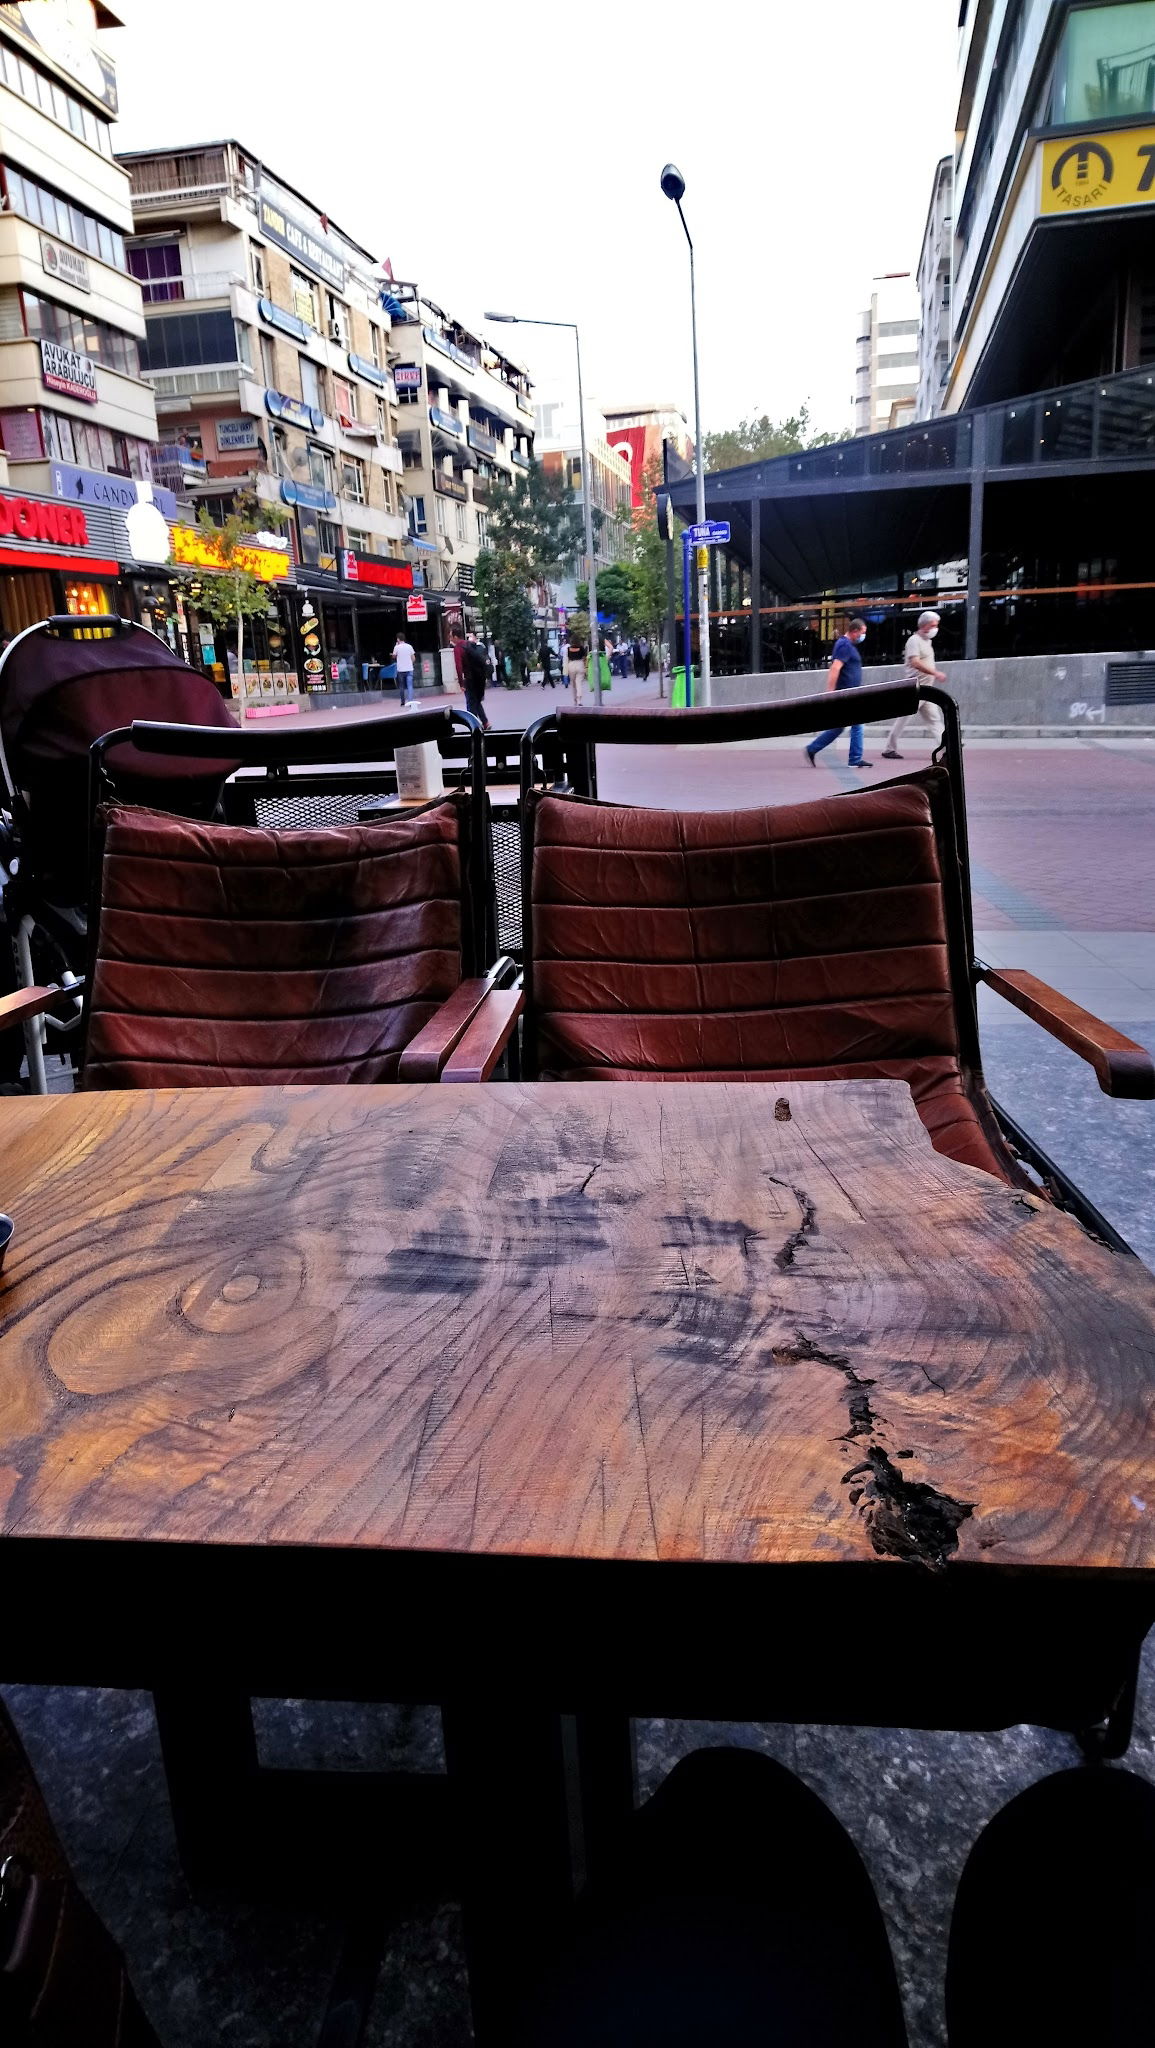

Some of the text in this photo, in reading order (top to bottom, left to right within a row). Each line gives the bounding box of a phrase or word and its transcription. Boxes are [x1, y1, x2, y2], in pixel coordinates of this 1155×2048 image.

[1057, 184, 1107, 207] TASARI
[44, 342, 81, 369] AVUKAT
[45, 358, 95, 389] ARABULUCU
